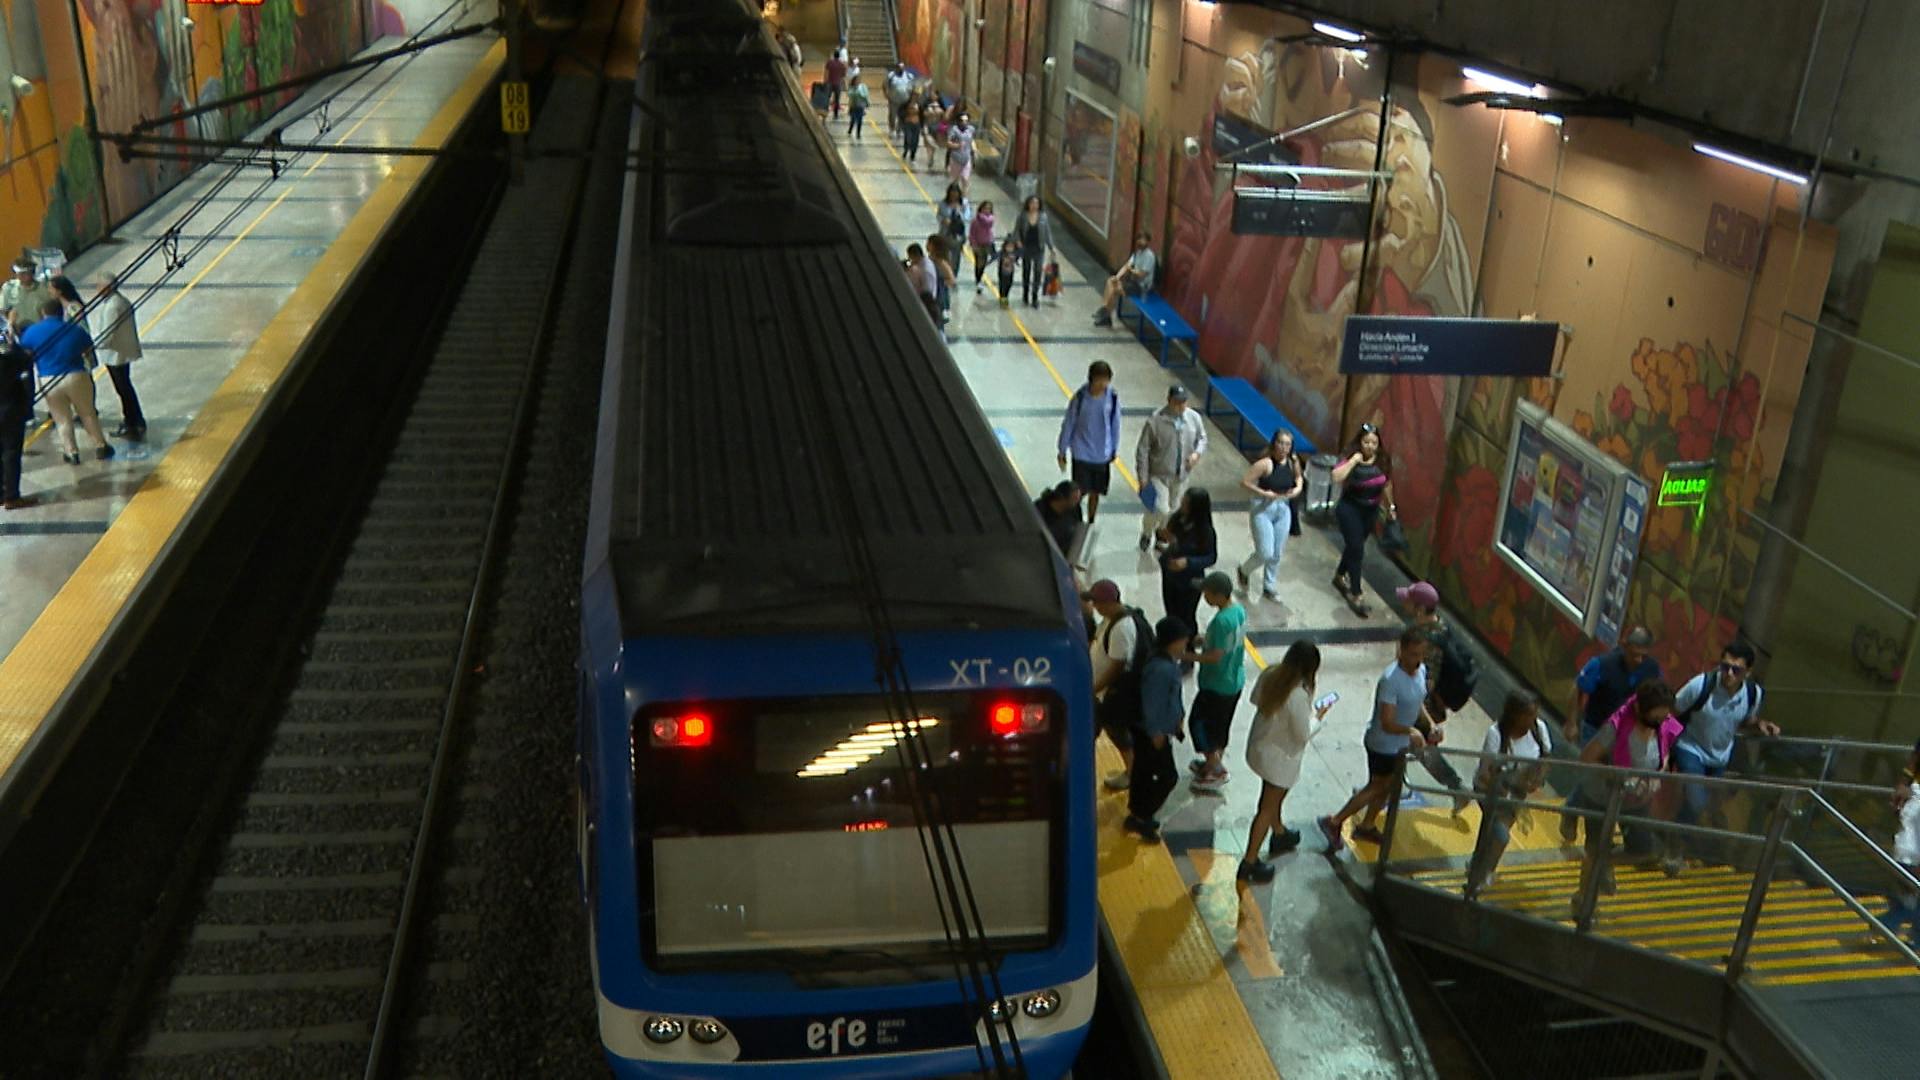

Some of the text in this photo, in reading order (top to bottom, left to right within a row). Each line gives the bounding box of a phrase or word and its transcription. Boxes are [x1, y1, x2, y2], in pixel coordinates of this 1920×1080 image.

[506, 85, 525, 105] 08
[508, 110, 525, 130] 19
[806, 1016, 867, 1055] efe
